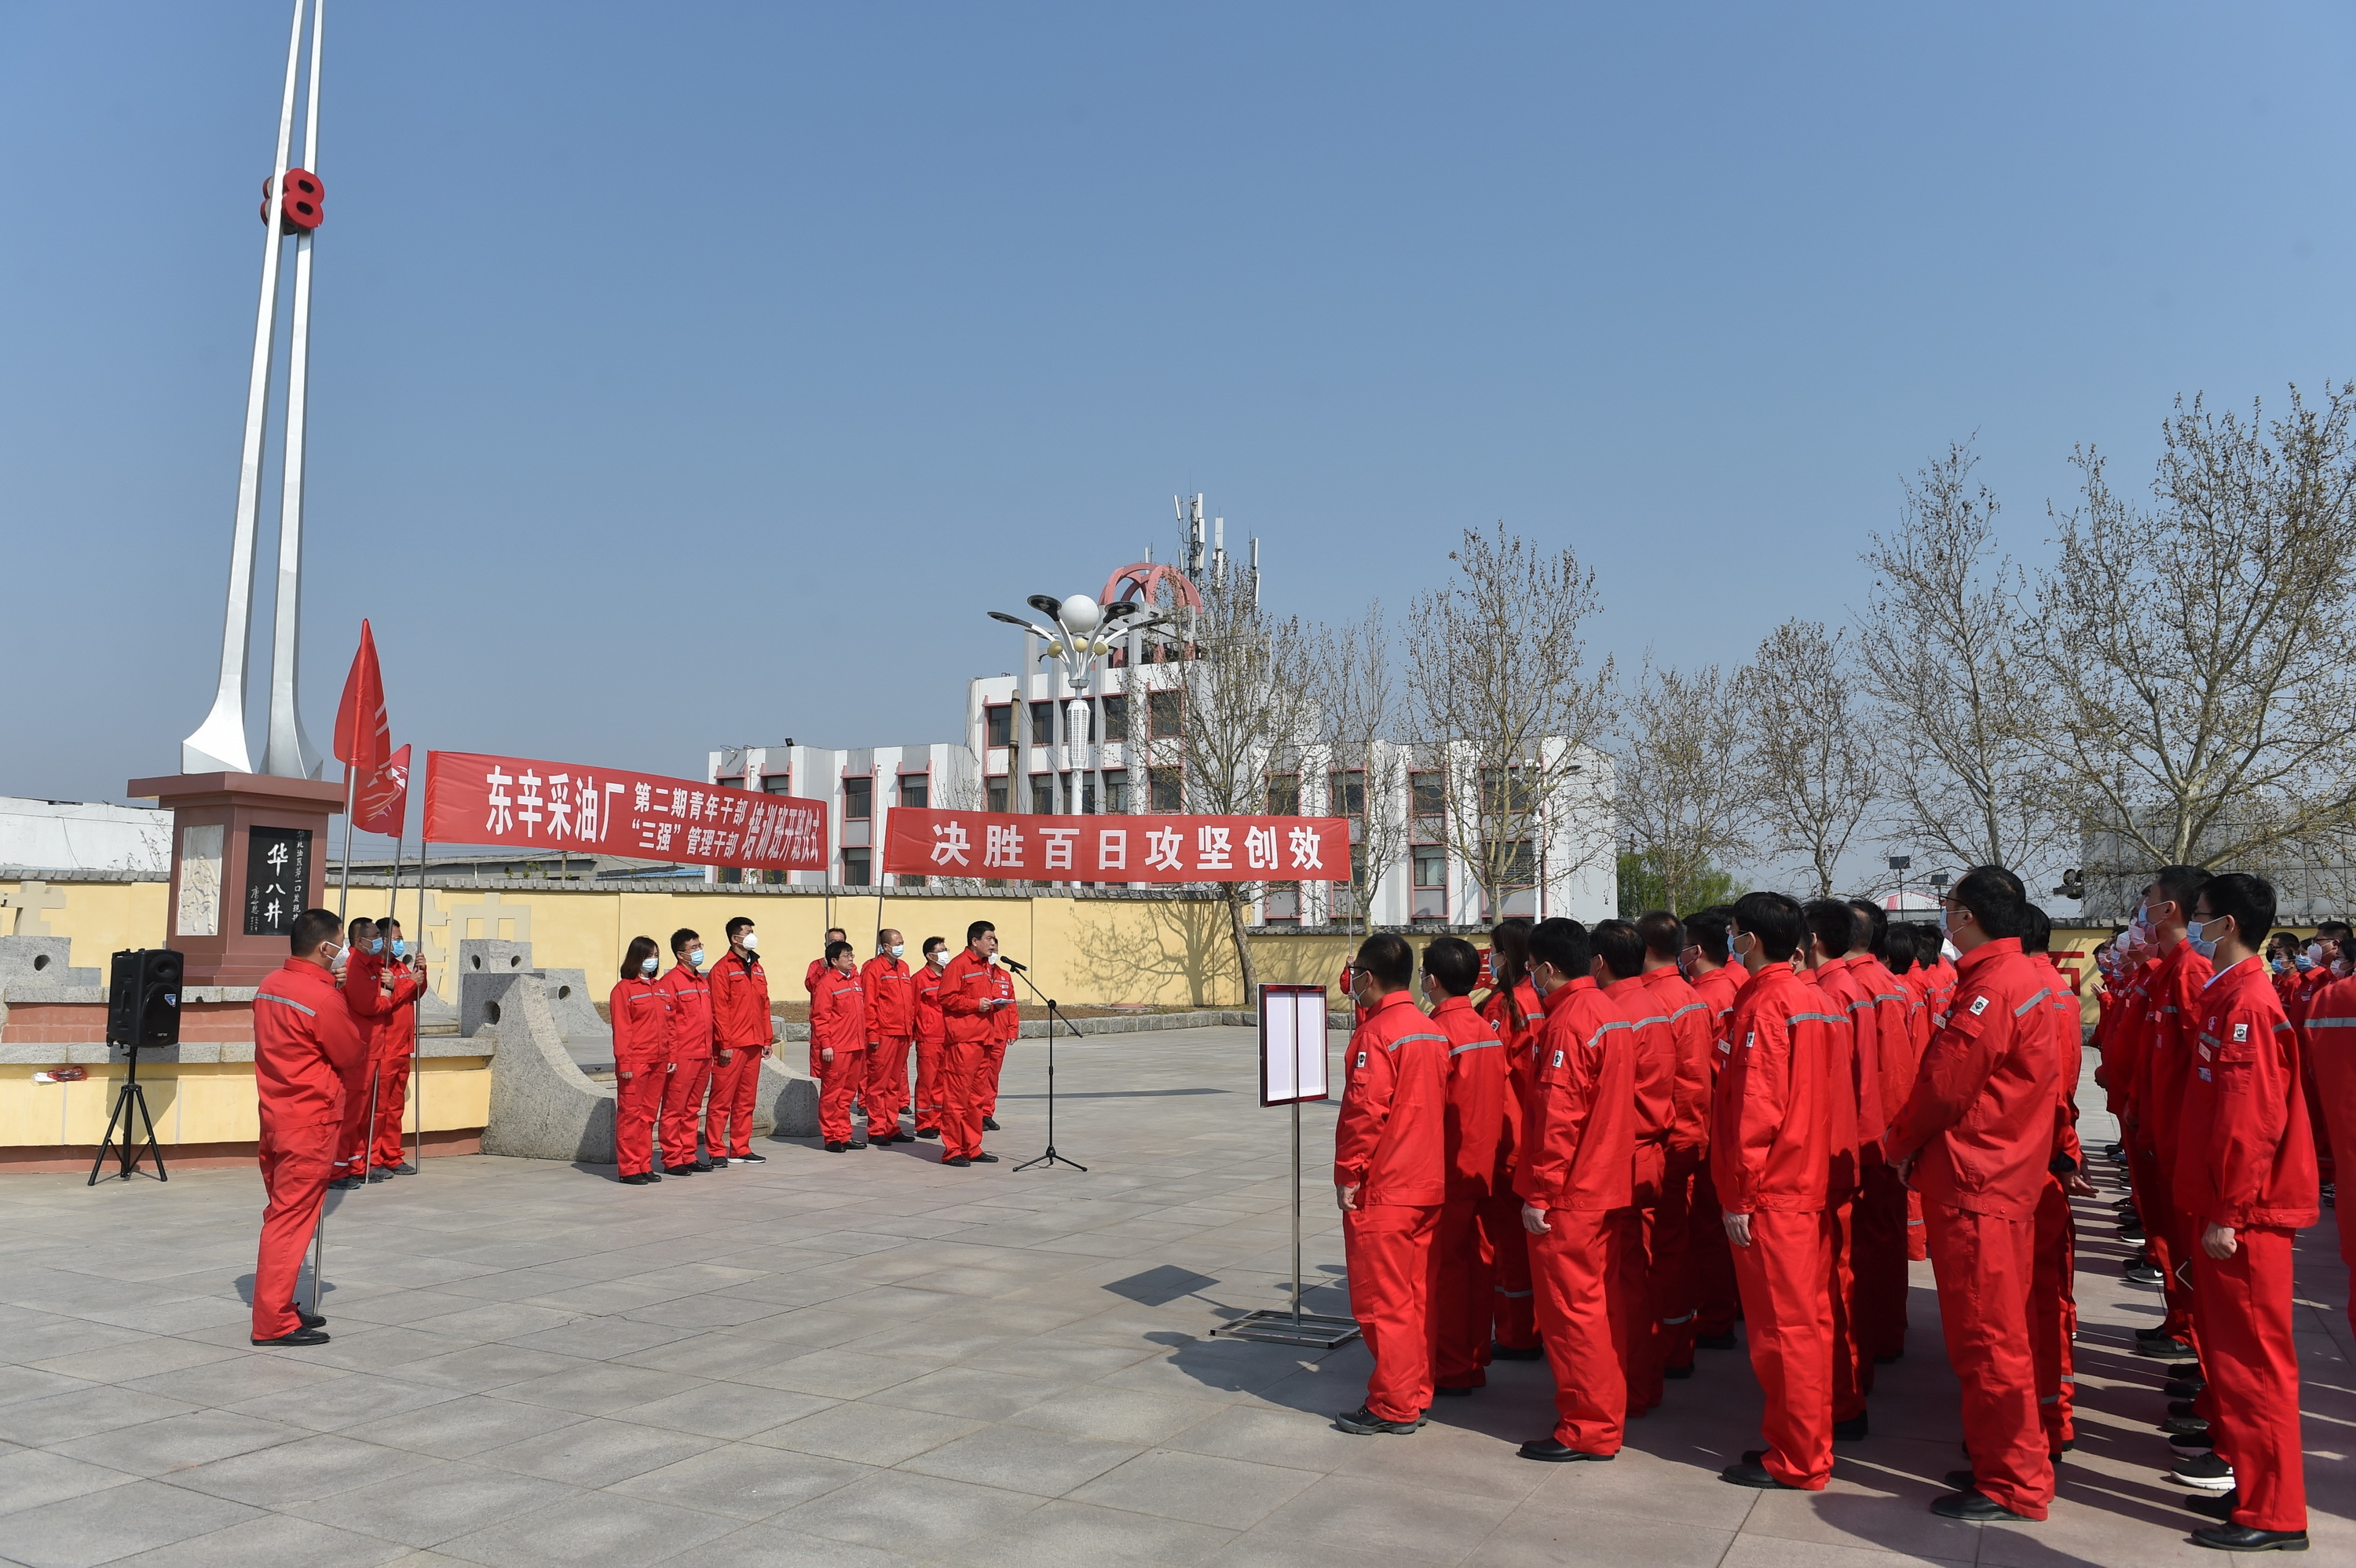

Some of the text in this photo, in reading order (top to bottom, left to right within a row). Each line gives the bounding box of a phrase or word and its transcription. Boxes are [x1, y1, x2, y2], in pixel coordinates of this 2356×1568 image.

[485, 764, 626, 843] 东辛采油厂
[634, 780, 749, 827] 第二期青年干部
[741, 800, 820, 864] 培训班开班仪式
[930, 820, 1325, 872] 决胜百日攻坚创效
[263, 842, 289, 929] 华八井
